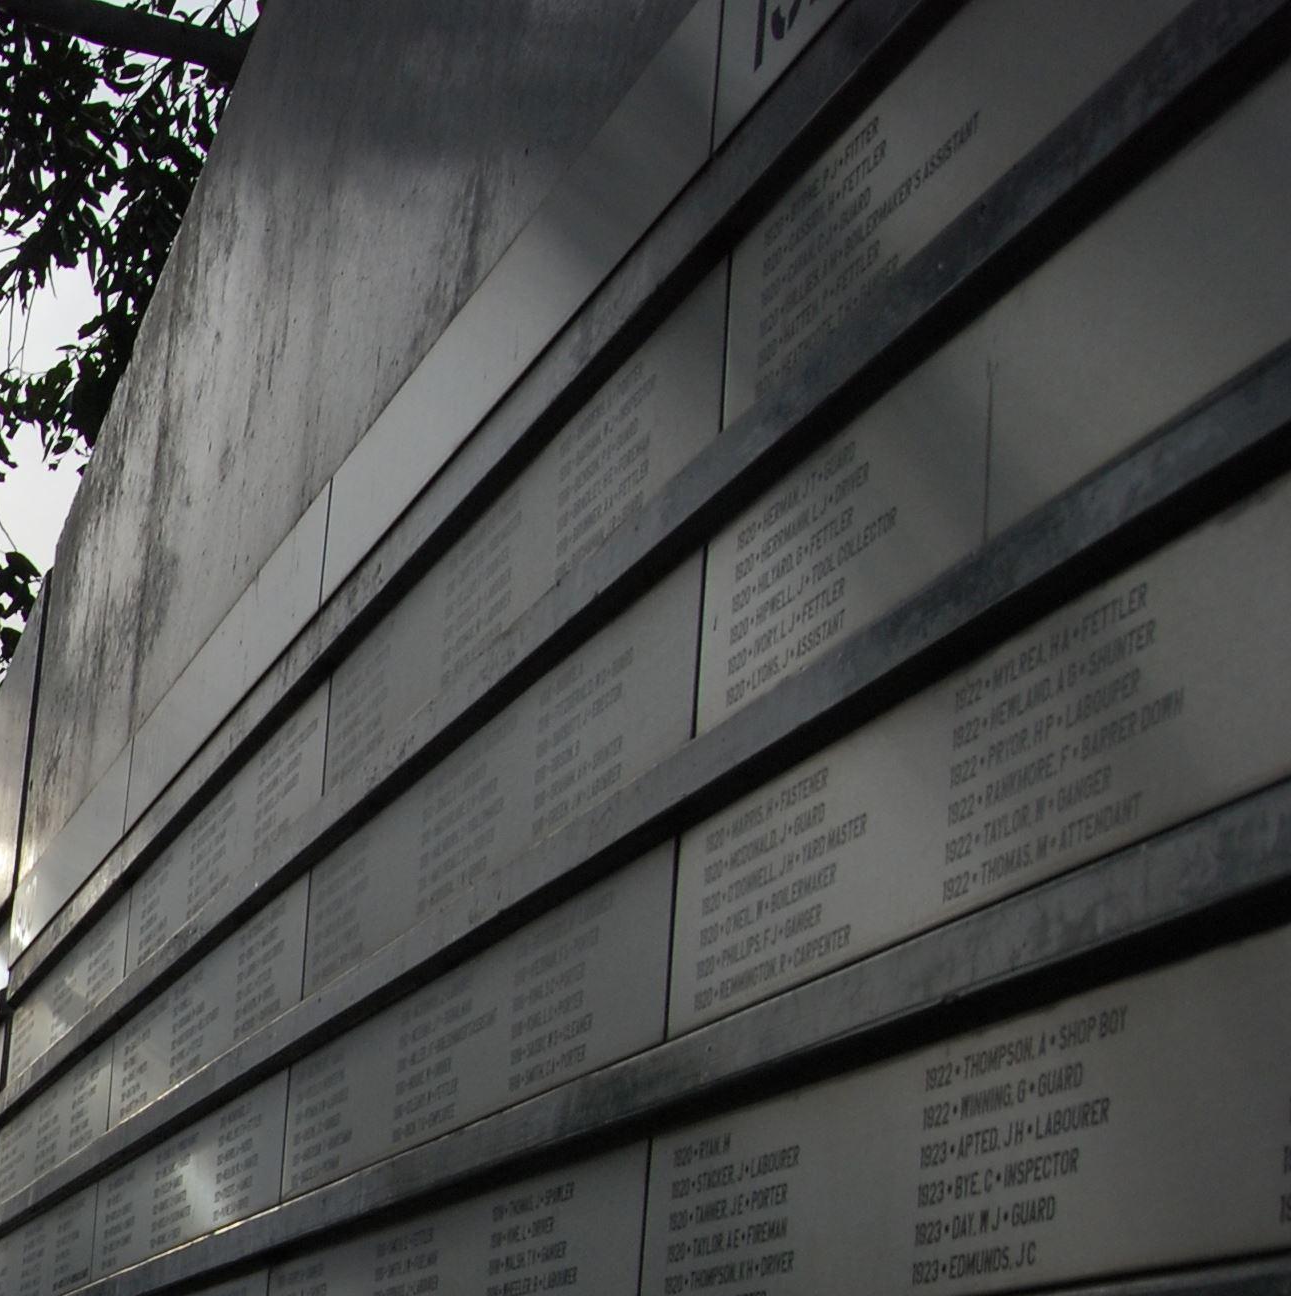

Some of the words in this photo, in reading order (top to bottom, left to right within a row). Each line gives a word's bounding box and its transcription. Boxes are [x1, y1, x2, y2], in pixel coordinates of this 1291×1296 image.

[923, 1061, 953, 1092] 1922
[1037, 1030, 1048, 1057] A
[1057, 1014, 1097, 1051] SHOP
[1098, 1004, 1128, 1038] BOY
[921, 1100, 950, 1131] 1922
[1016, 1078, 1026, 1103] G
[1036, 1061, 1084, 1098] GUARD
[918, 1139, 948, 1169] 1923
[1002, 1122, 1012, 1148] J
[1014, 1119, 1024, 1145] H
[1034, 1095, 1111, 1140] LABOURER
[916, 1179, 945, 1208] 1923
[983, 1167, 994, 1193] C
[1003, 1146, 1080, 1188] INSPECTOR
[913, 1219, 942, 1247] 1923
[978, 1208, 990, 1234] W
[991, 1206, 1001, 1231] J
[1010, 1194, 1056, 1227] GUARD
[911, 1258, 939, 1286] 1923
[1014, 1242, 1025, 1268] J
[1026, 1239, 1037, 1266] C
